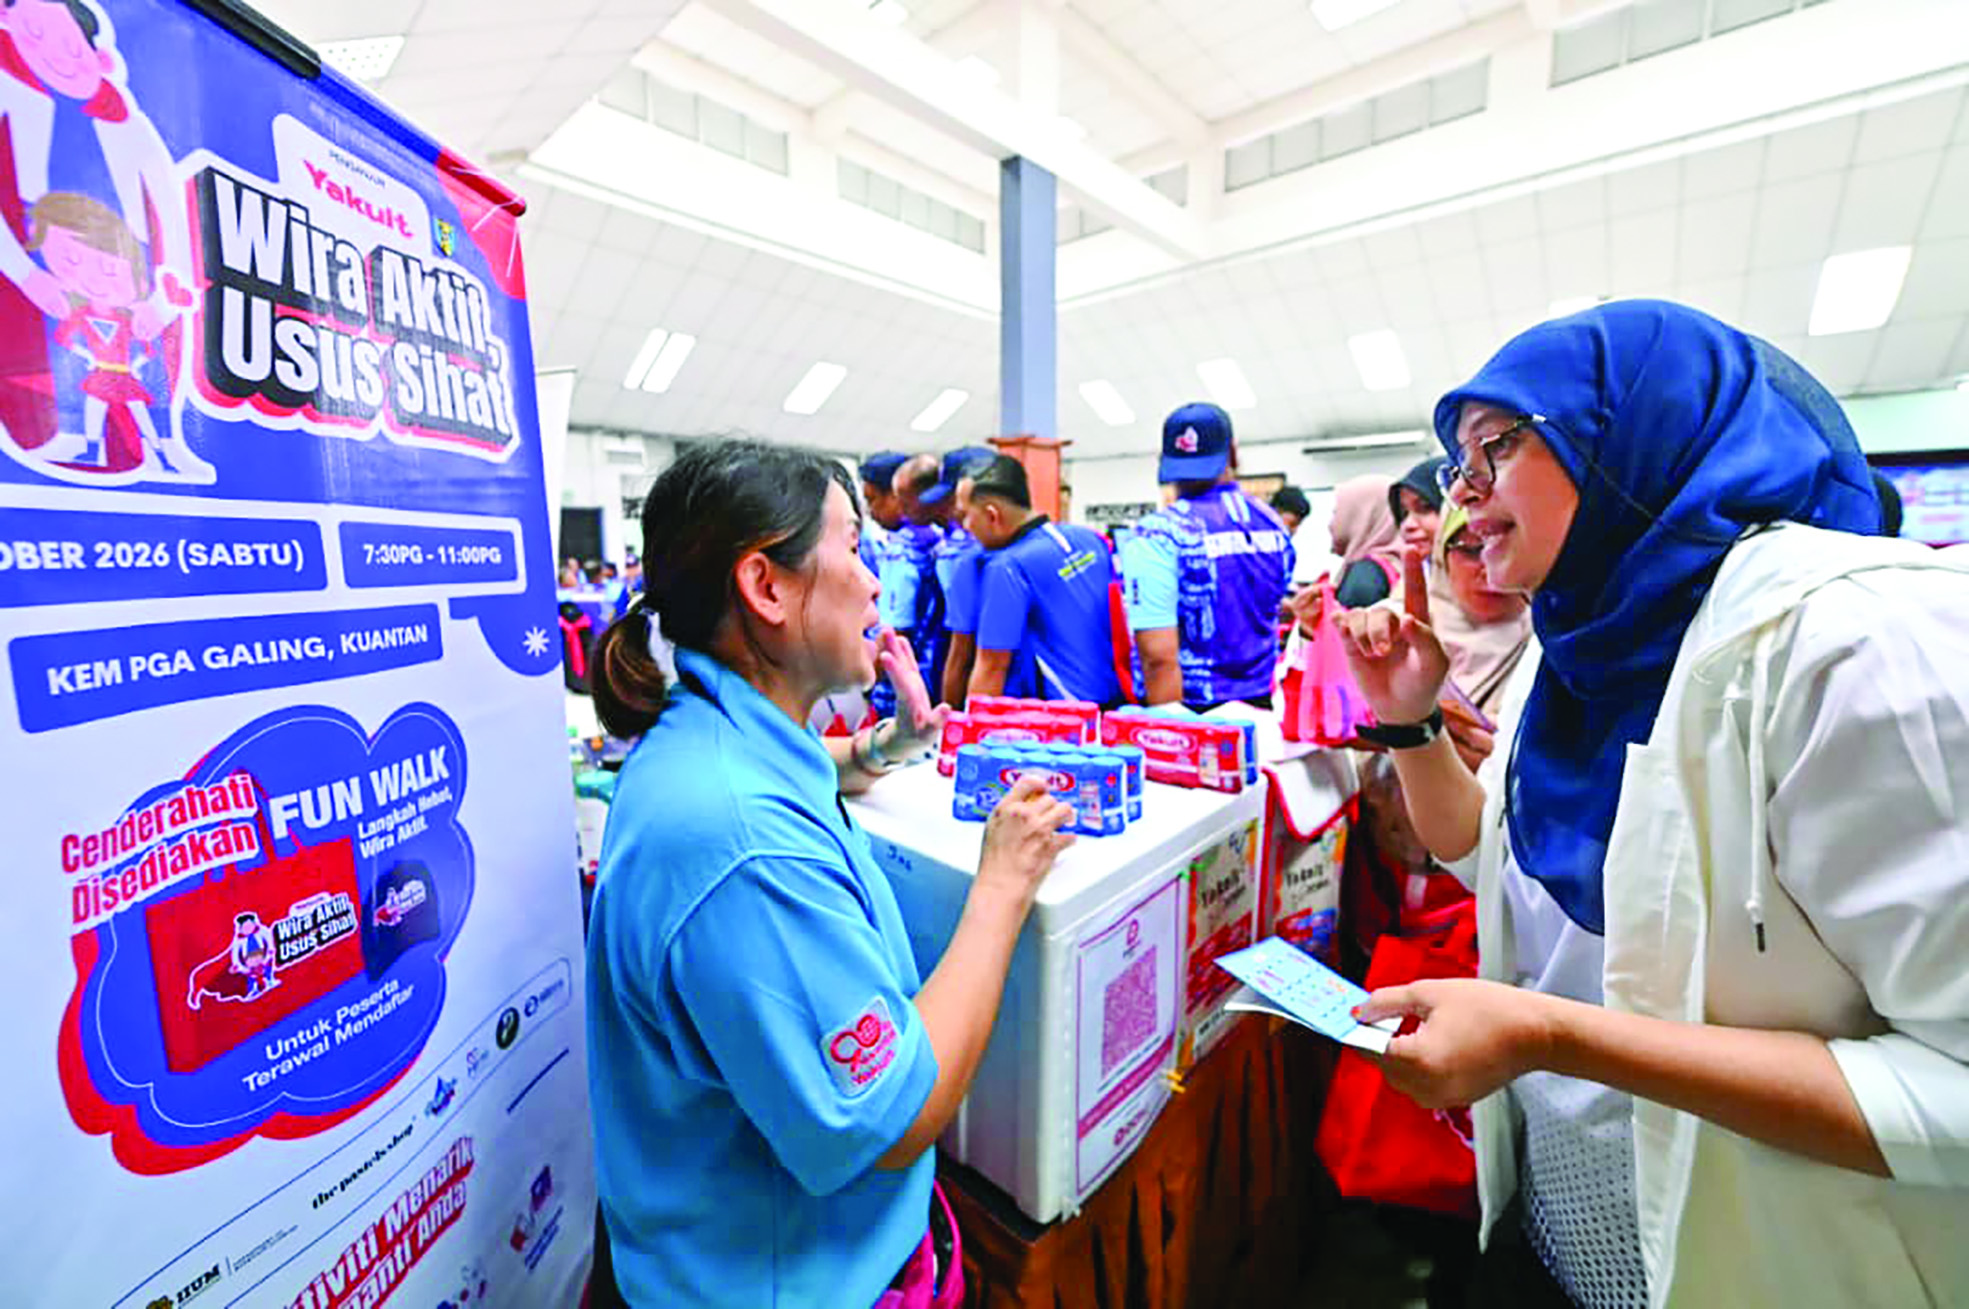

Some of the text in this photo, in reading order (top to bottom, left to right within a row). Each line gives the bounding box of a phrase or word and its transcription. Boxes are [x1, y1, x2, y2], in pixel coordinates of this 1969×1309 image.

[303, 160, 414, 239] Yakult
[213, 172, 367, 317] Wira
[221, 285, 510, 434] Usus Sihat
[93, 541, 171, 569] 2026
[177, 538, 304, 574] (SABTU)
[362, 543, 424, 566] 7:30PG
[437, 545, 502, 565] 11:00PG
[46, 624, 429, 696] KEM PGA GALING, KUANTAN
[61, 776, 257, 873] Cenderahati
[269, 744, 450, 840] FUN WALK
[357, 801, 418, 840] Langkah
[72, 824, 258, 924] Disediakan
[359, 833, 396, 860] Wira
[242, 983, 415, 1092] Terawal Mendaftar
[265, 979, 400, 1060] Untuk Peserta
[382, 1136, 476, 1246] Menarik
[416, 1179, 467, 1249] Anda
